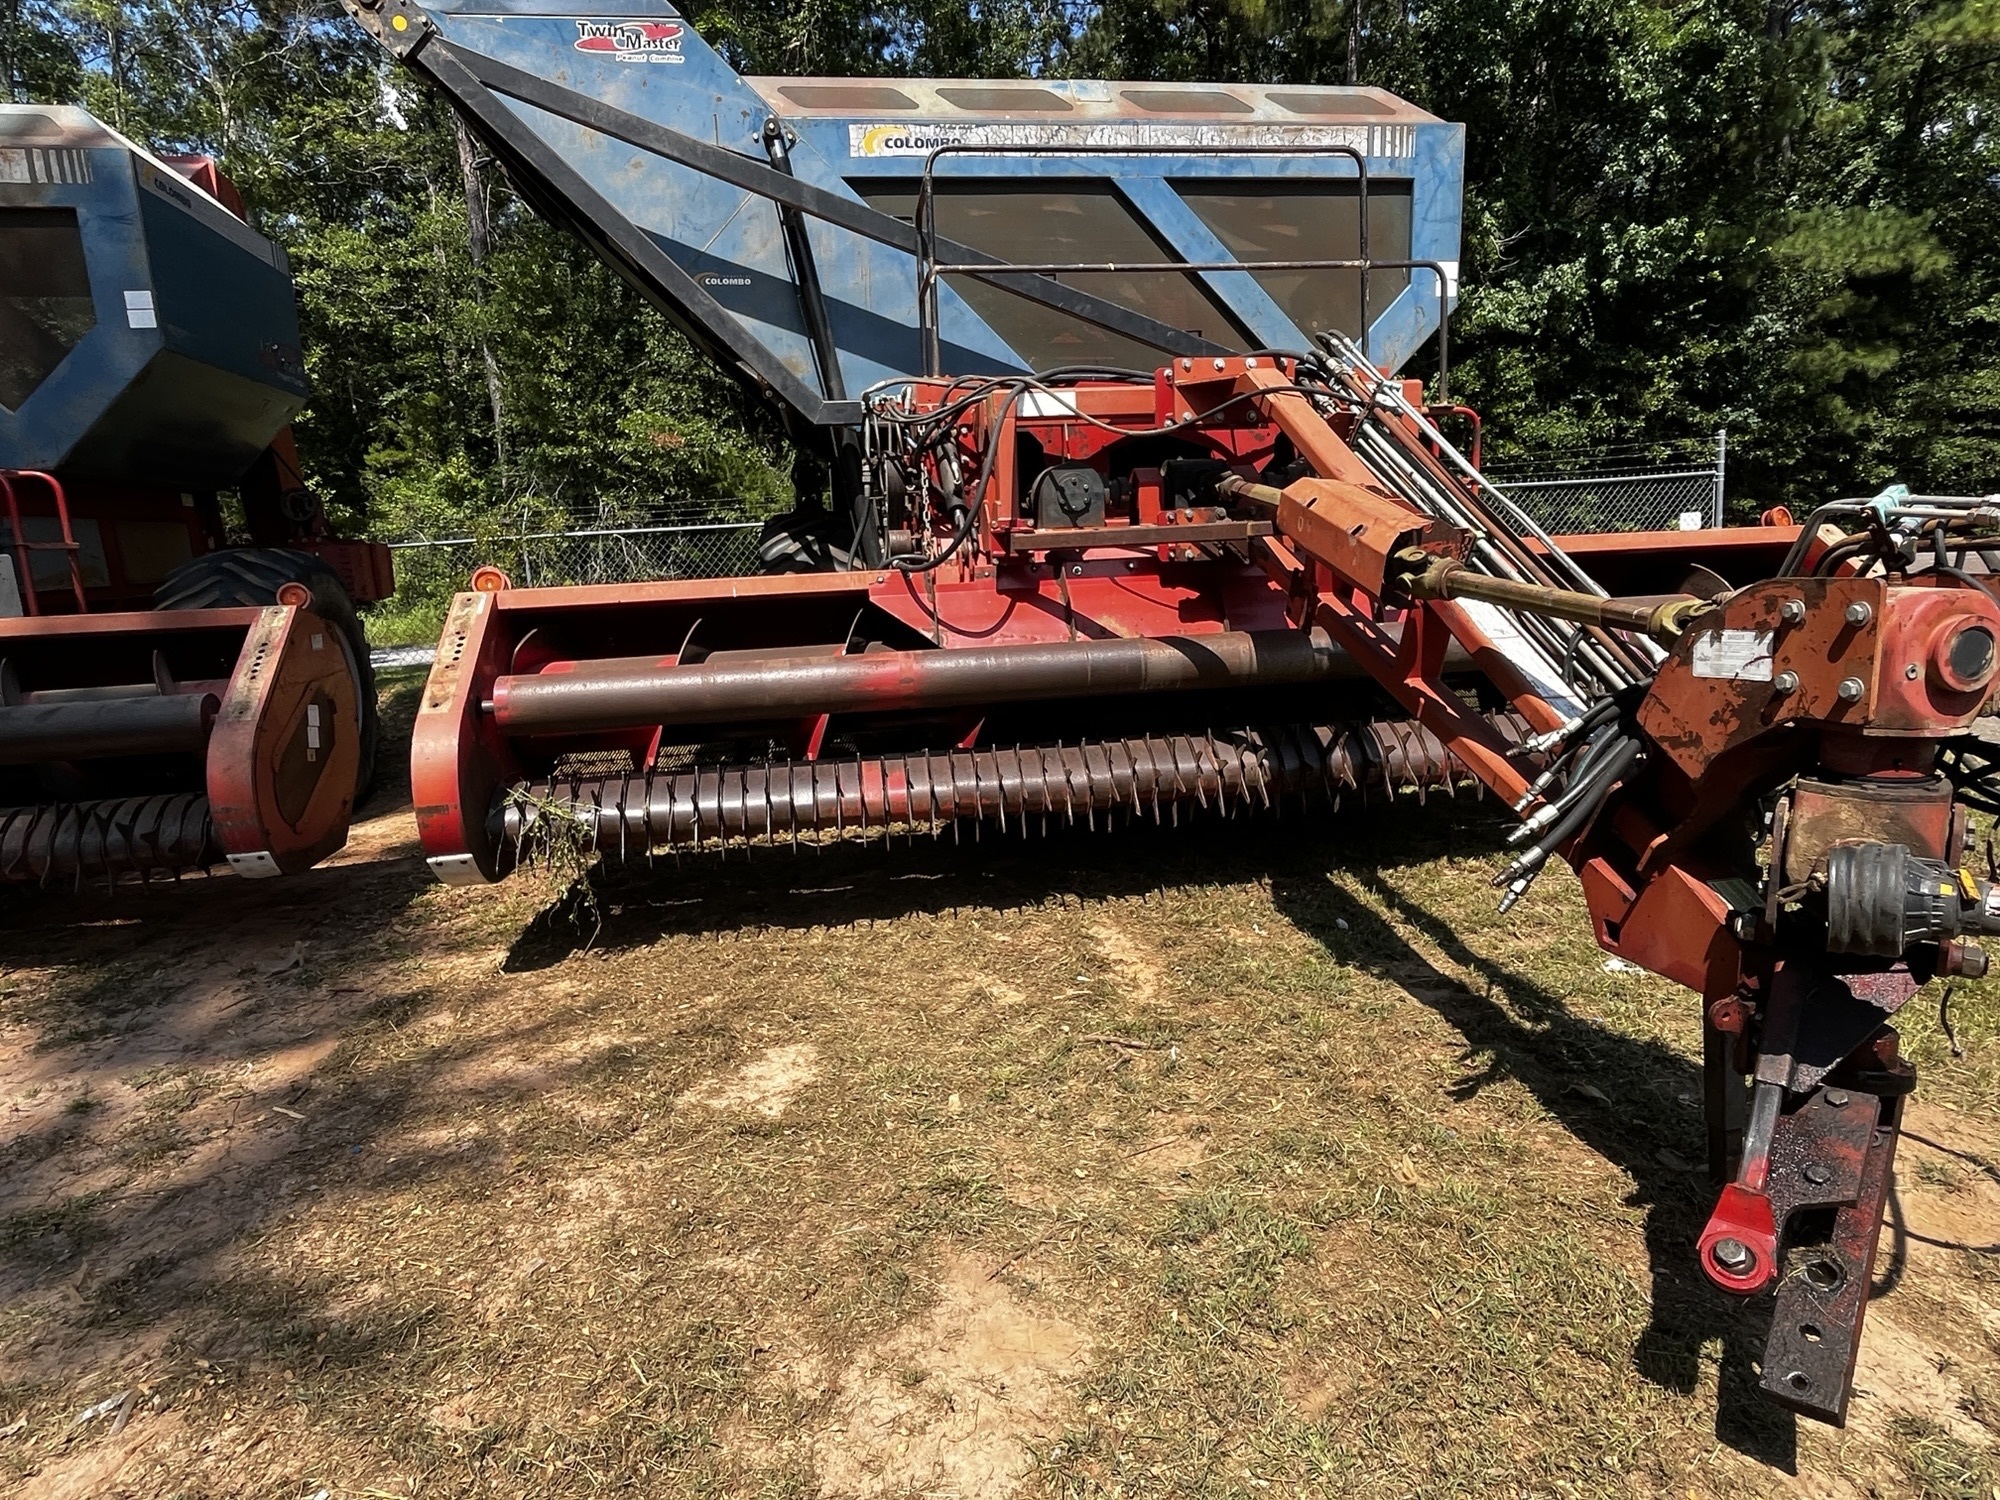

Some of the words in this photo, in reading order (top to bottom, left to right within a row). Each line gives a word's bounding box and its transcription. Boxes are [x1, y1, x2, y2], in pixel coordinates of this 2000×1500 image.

[577, 22, 625, 38] Twin
[626, 34, 680, 50] Master
[154, 178, 191, 209] COLOMBO
